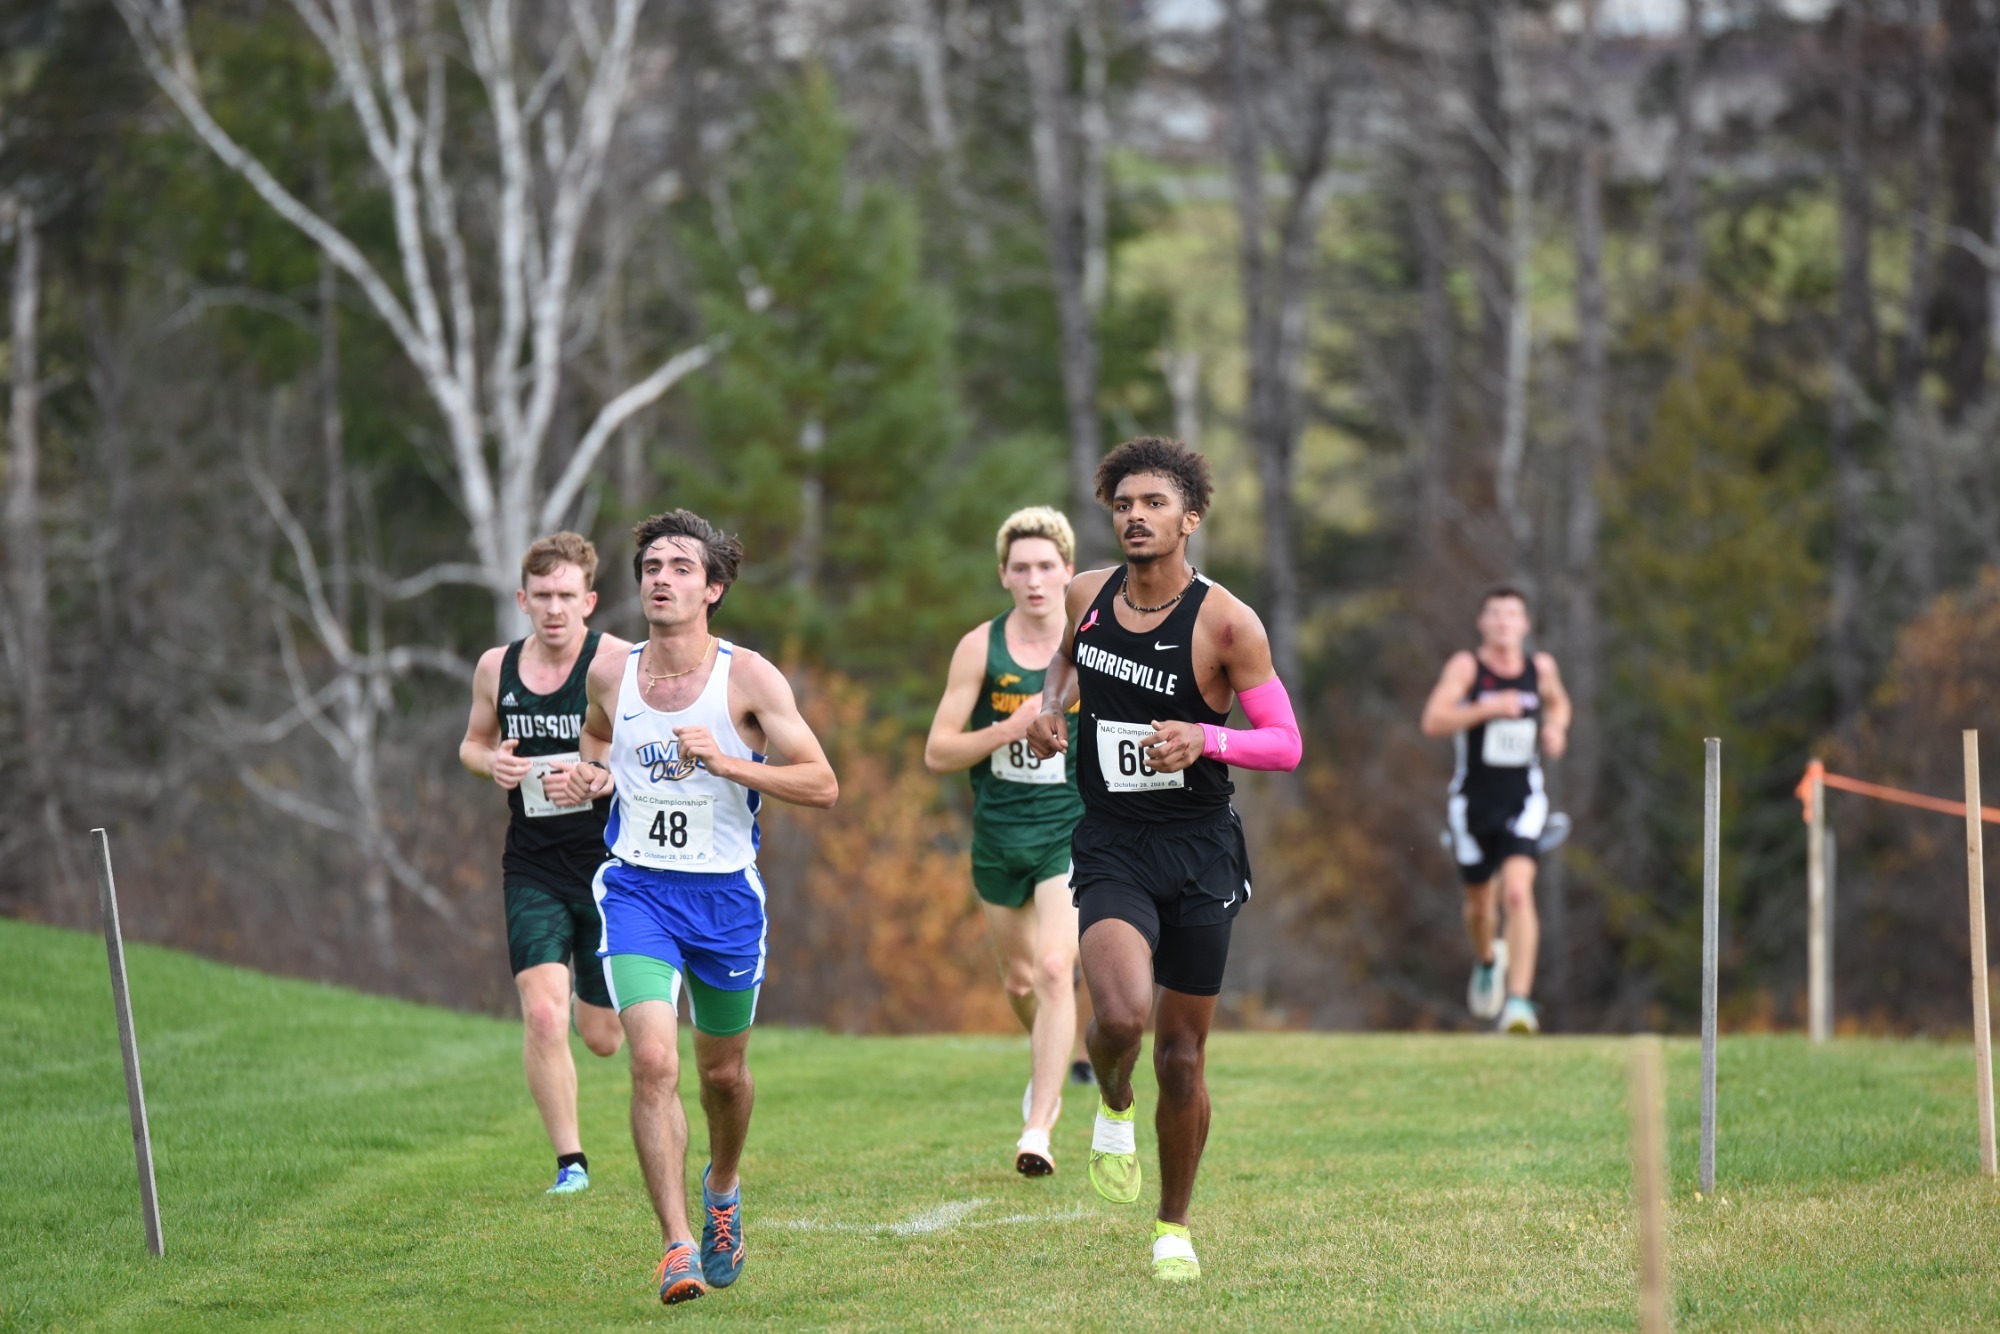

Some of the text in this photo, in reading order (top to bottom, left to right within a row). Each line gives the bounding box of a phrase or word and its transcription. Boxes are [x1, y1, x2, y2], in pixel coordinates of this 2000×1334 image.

[1077, 642, 1178, 696] MORRISVILLE
[506, 714, 581, 739] HUSSON
[1100, 725, 1116, 734] NAC
[650, 760, 696, 784] Owls
[633, 794, 708, 807] NAC Championships
[648, 810, 688, 849] 48
[644, 851, 667, 860] October
